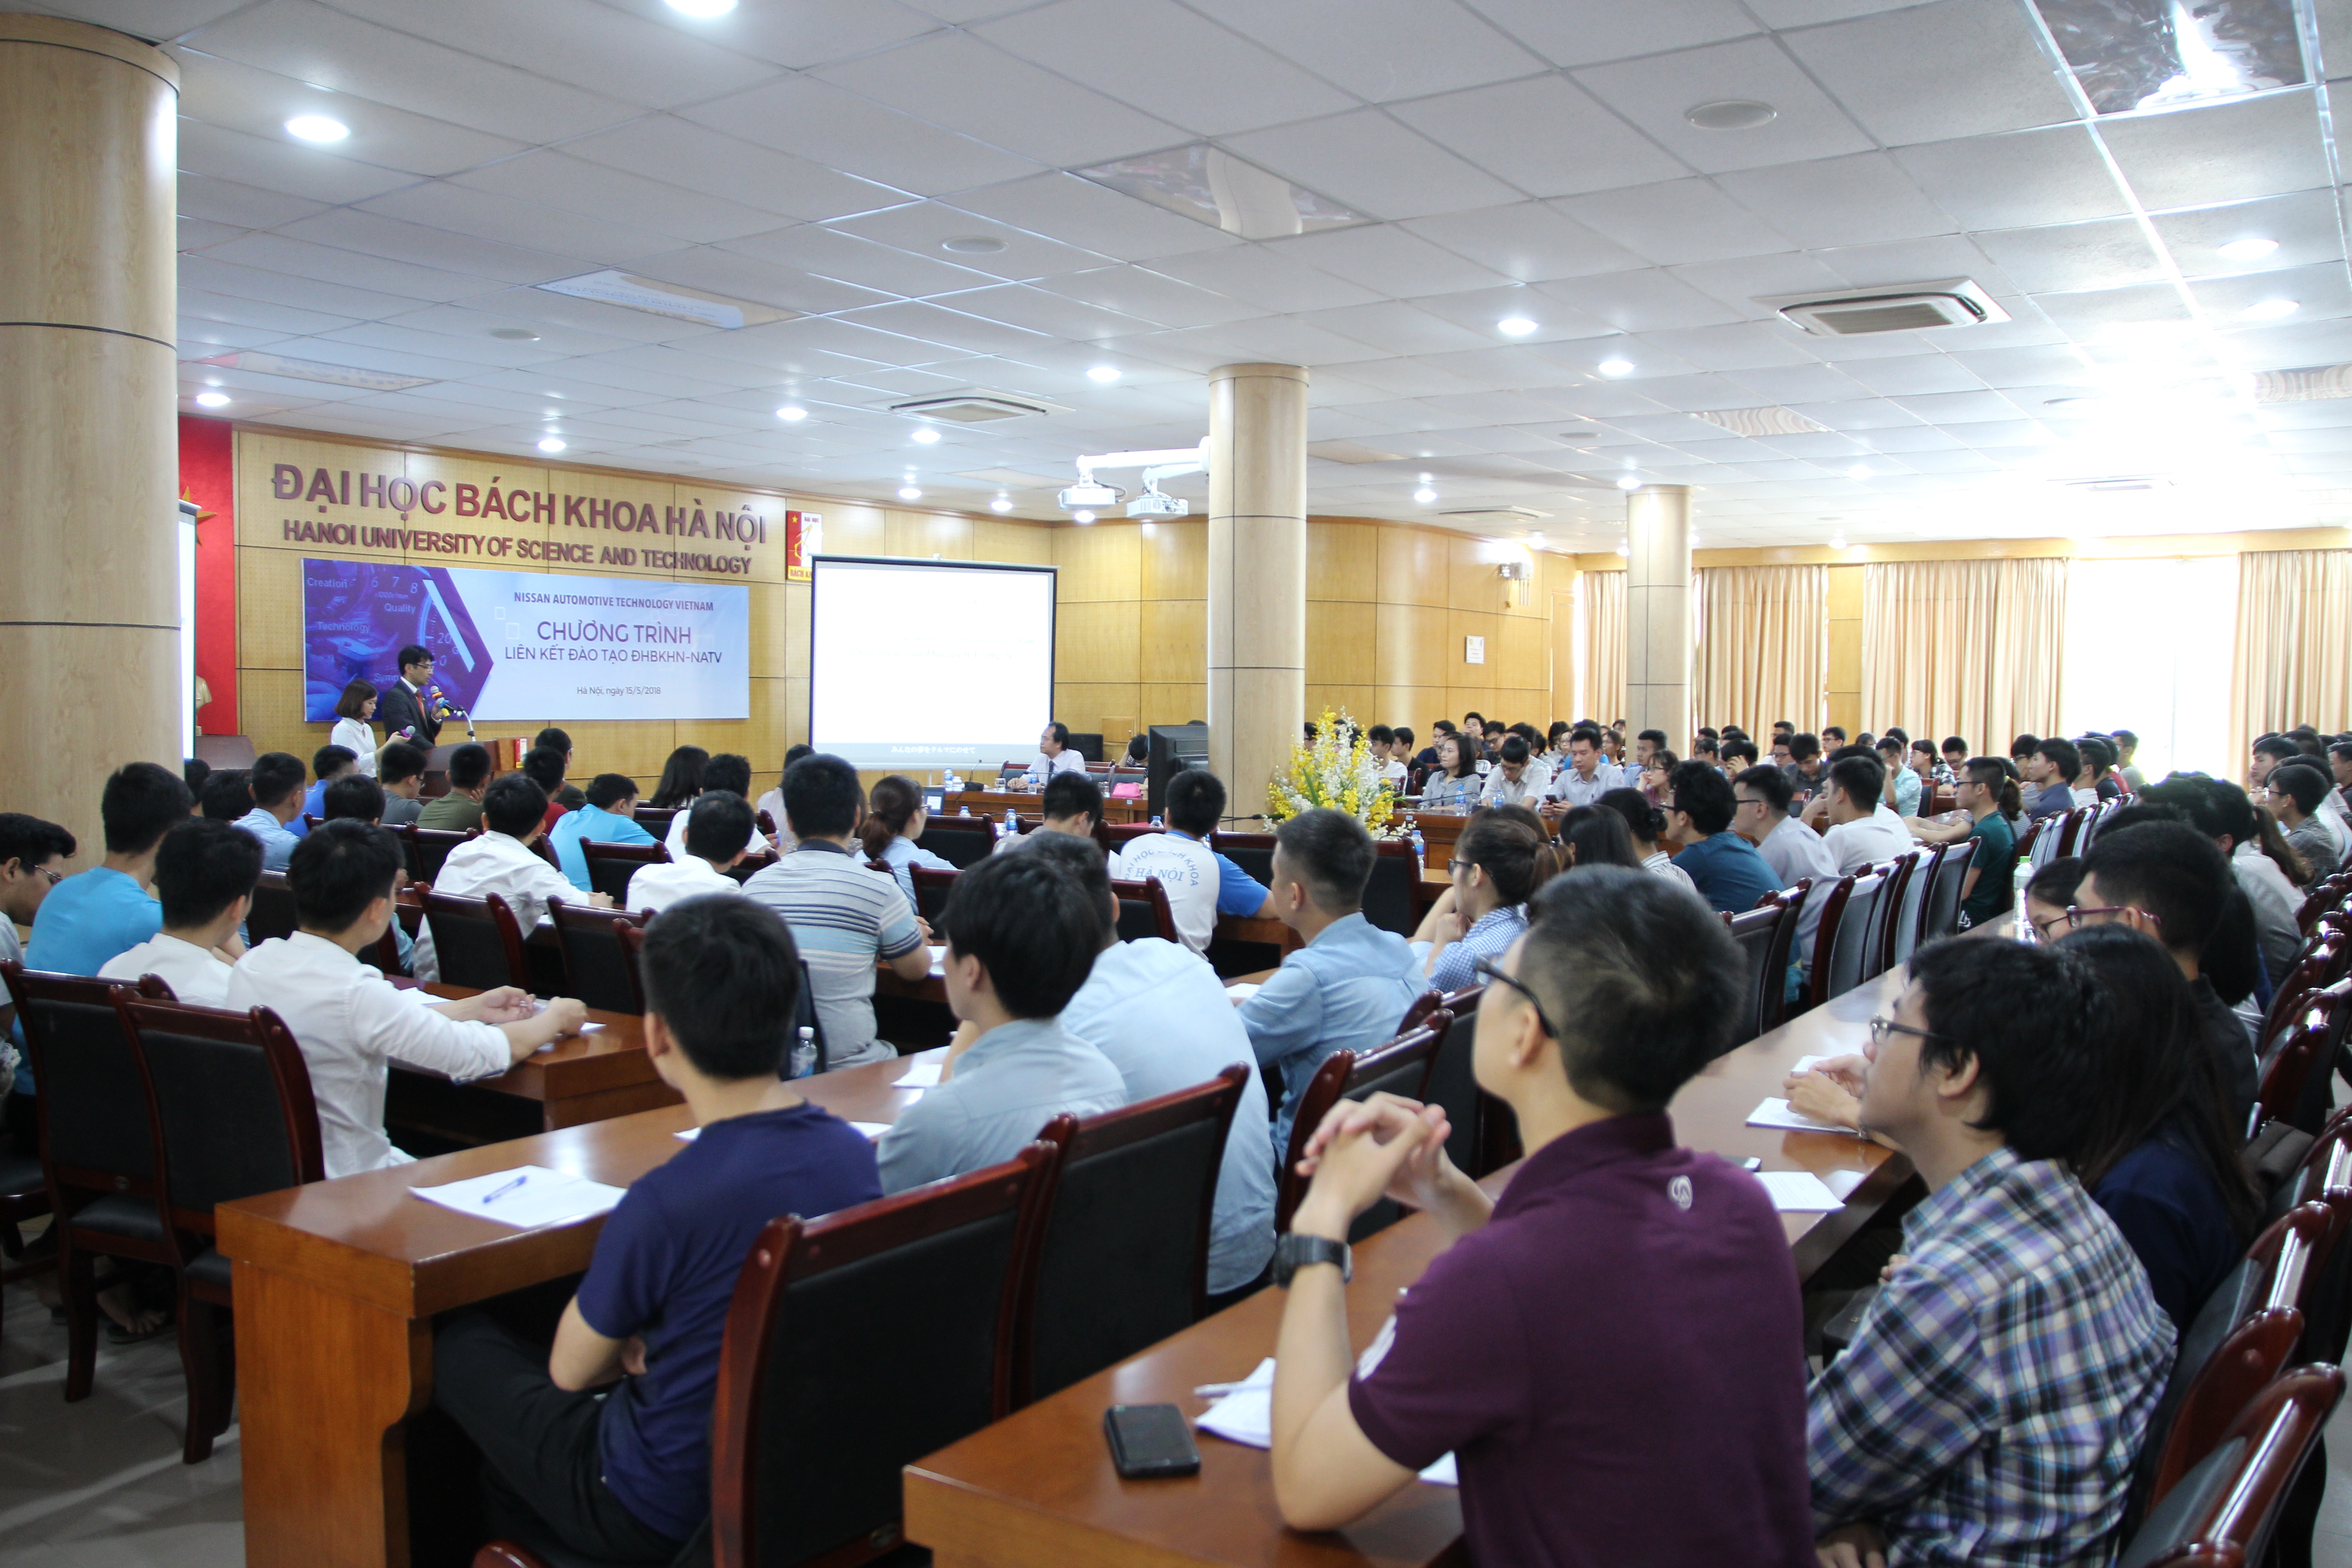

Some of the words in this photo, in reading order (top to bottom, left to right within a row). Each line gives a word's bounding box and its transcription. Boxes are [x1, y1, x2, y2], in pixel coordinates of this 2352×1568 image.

[271, 463, 350, 513] ĐẠI
[361, 472, 447, 521] HỌC
[456, 476, 556, 525] BÁCH
[564, 494, 660, 534] KHOA
[666, 498, 711, 539] HÀ
[717, 504, 766, 551] NỘI
[284, 519, 357, 545] HANOI
[363, 525, 486, 555] UNIVERSITY
[487, 536, 514, 558] OF
[516, 537, 594, 564] SCIENCE
[600, 546, 637, 567] AND
[642, 549, 752, 574] TECHNOLOGY
[307, 578, 348, 588] Creation
[372, 576, 378, 588] 6
[392, 576, 399, 587] 7
[410, 583, 417, 593] 8
[384, 603, 416, 614] Quality
[514, 592, 550, 603] NISSAN
[553, 594, 614, 606] AUTOMOTIVE
[616, 597, 674, 609] TECHNOLOGY
[675, 600, 713, 611] VIETNAM
[317, 622, 370, 634] Technology
[537, 619, 629, 642] CHƯƠNG
[633, 621, 691, 644] TRÌNH
[505, 643, 535, 660] LIÊN
[540, 643, 565, 660] KẾT
[568, 646, 598, 661] ĐÀO
[601, 649, 628, 664] TẠO
[631, 649, 722, 663] ĐHBKHN-NATV
[589, 686, 604, 696] Nội,
[606, 687, 624, 696] ngày
[626, 686, 661, 695] 15/5/2018
[1135, 866, 1153, 877] HÀ
[1157, 867, 1185, 882] NỘI
[1184, 858, 1199, 886] KHOA
